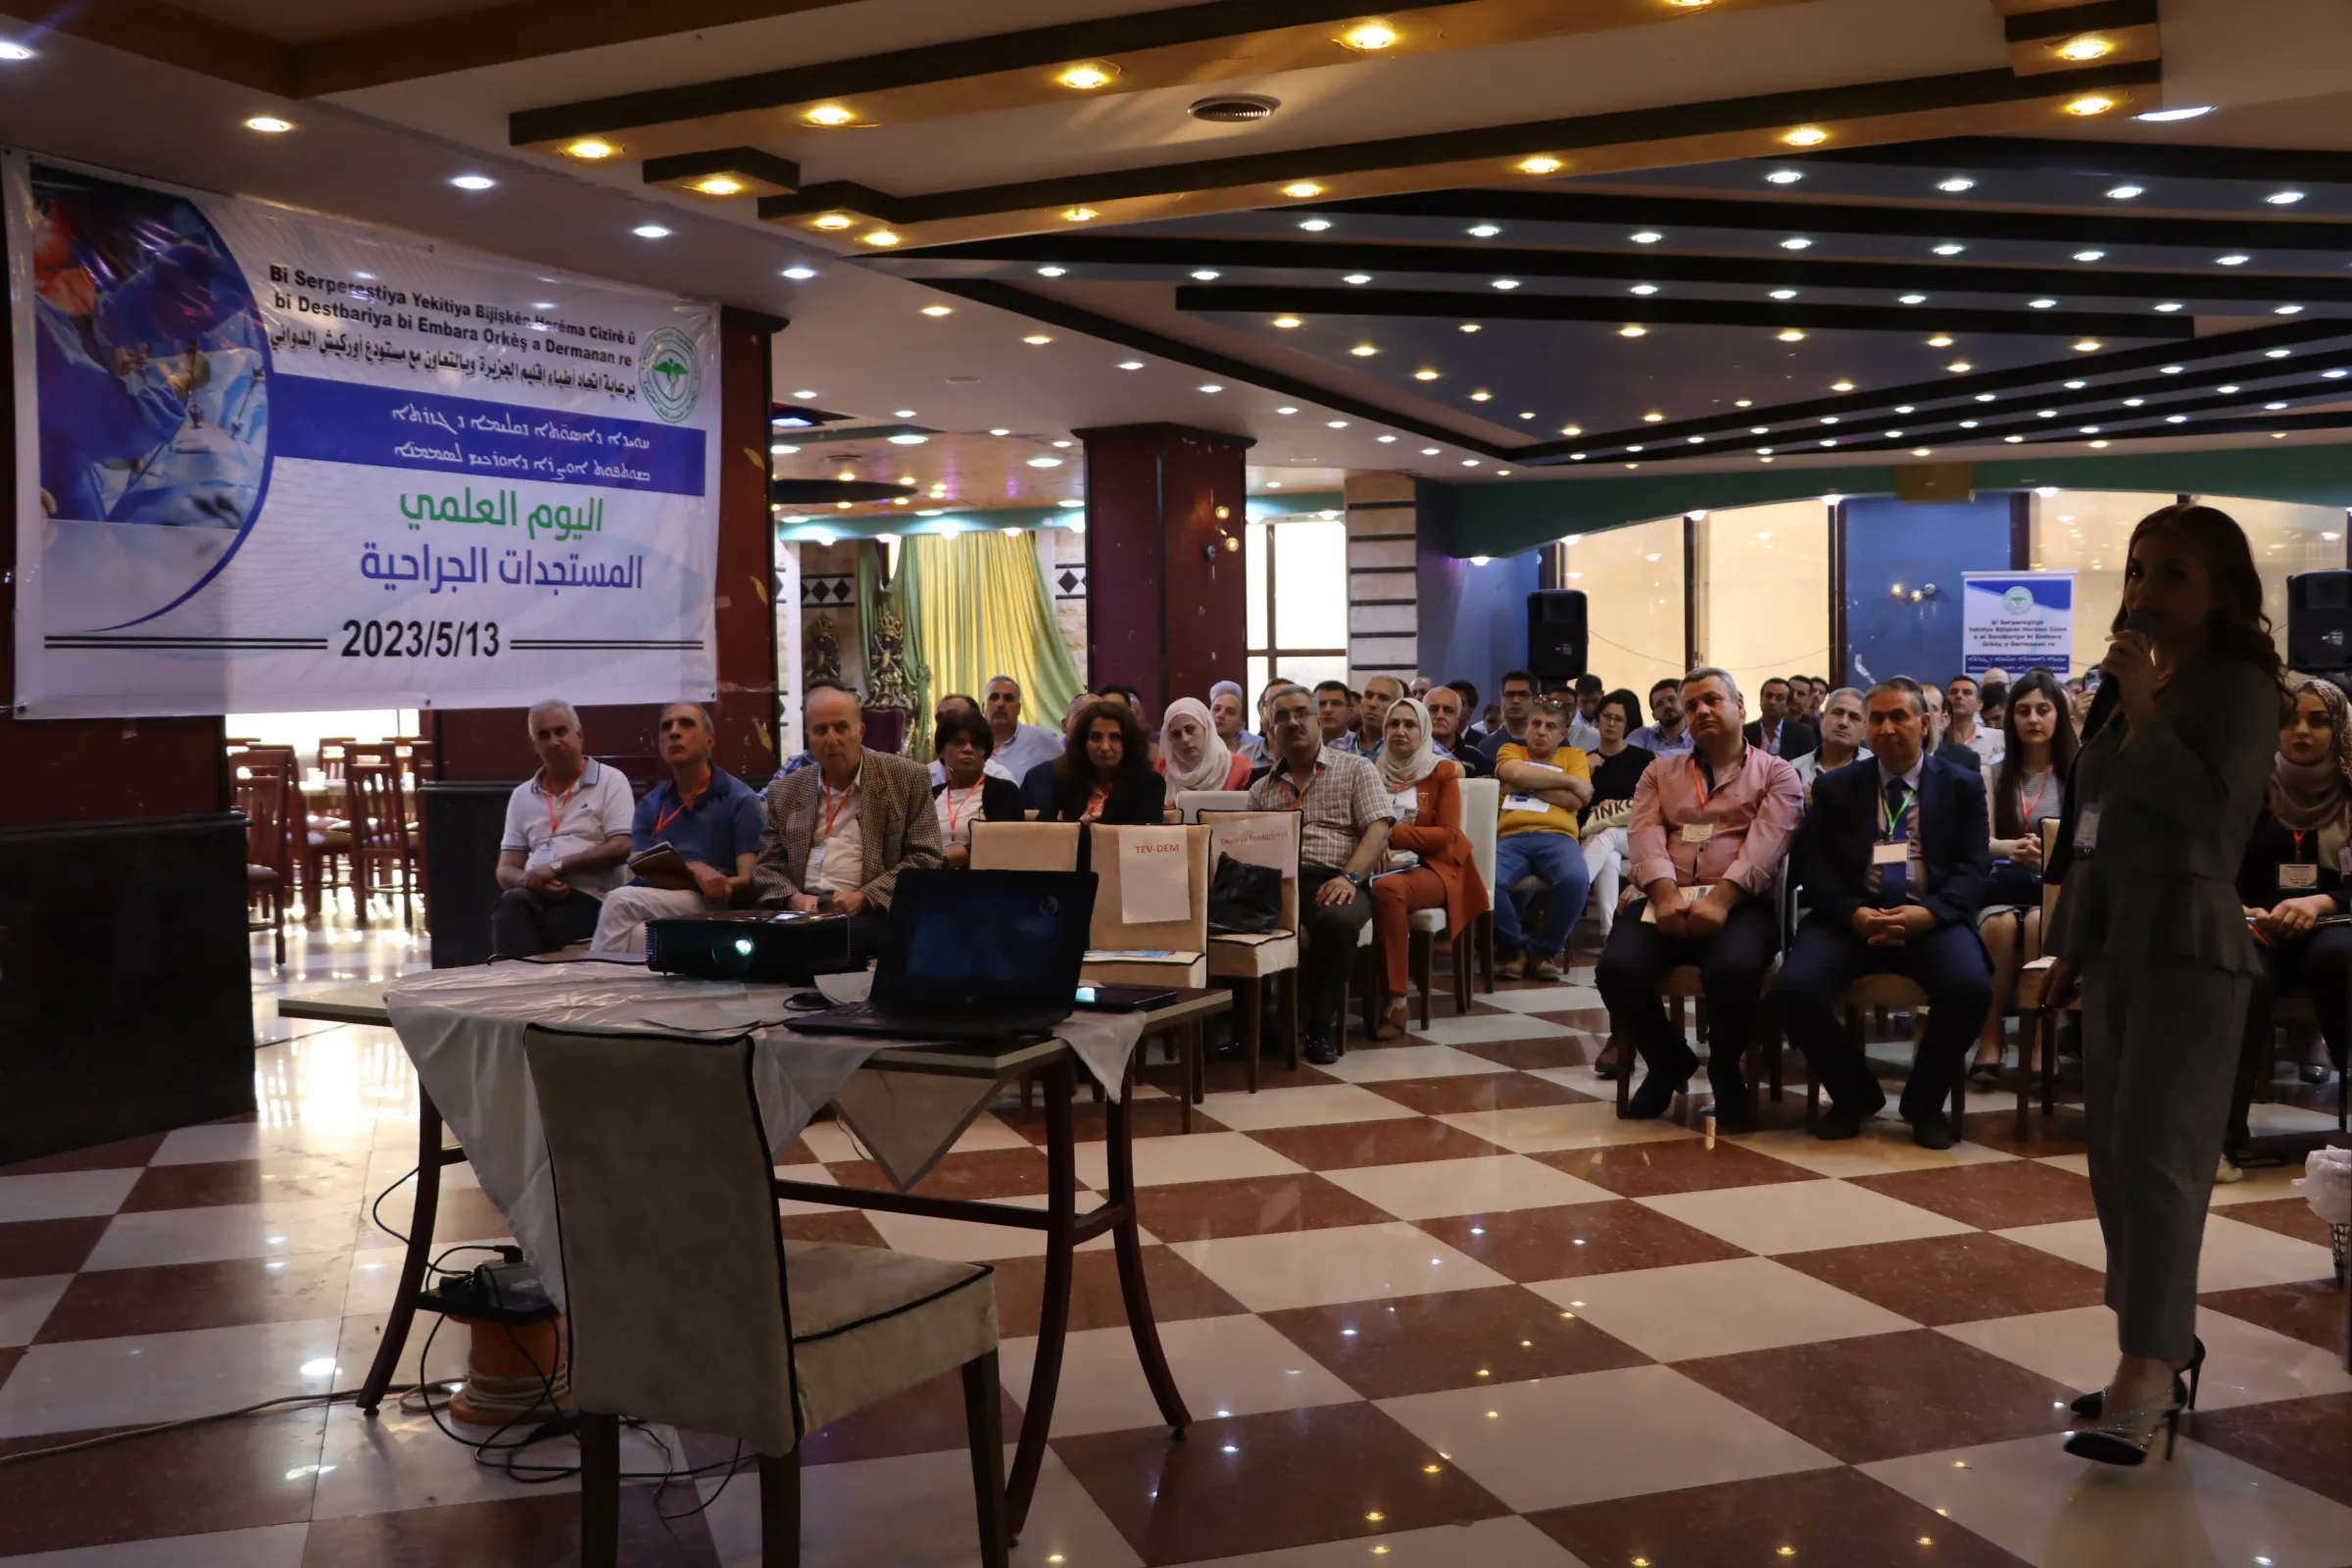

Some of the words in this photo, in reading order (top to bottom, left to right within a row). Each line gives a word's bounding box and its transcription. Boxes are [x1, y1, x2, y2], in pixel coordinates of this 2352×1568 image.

[270, 265, 288, 284] Bi
[628, 329, 636, 346] û
[274, 292, 291, 311] bi
[298, 296, 392, 329] Destbariya
[398, 313, 413, 330] bi
[418, 317, 478, 341] Embara
[483, 328, 527, 352] Orkêş
[532, 339, 541, 351] a
[546, 338, 615, 365] Dermanan
[619, 354, 632, 367] re
[408, 348, 421, 370] مع
[399, 487, 517, 532] العلمي
[527, 496, 604, 542] اليوم
[361, 542, 488, 594] الجراحية
[498, 549, 643, 597] المستجدات
[341, 617, 501, 660] 2023/5/13
[1135, 844, 1180, 855] TEV-DEM
